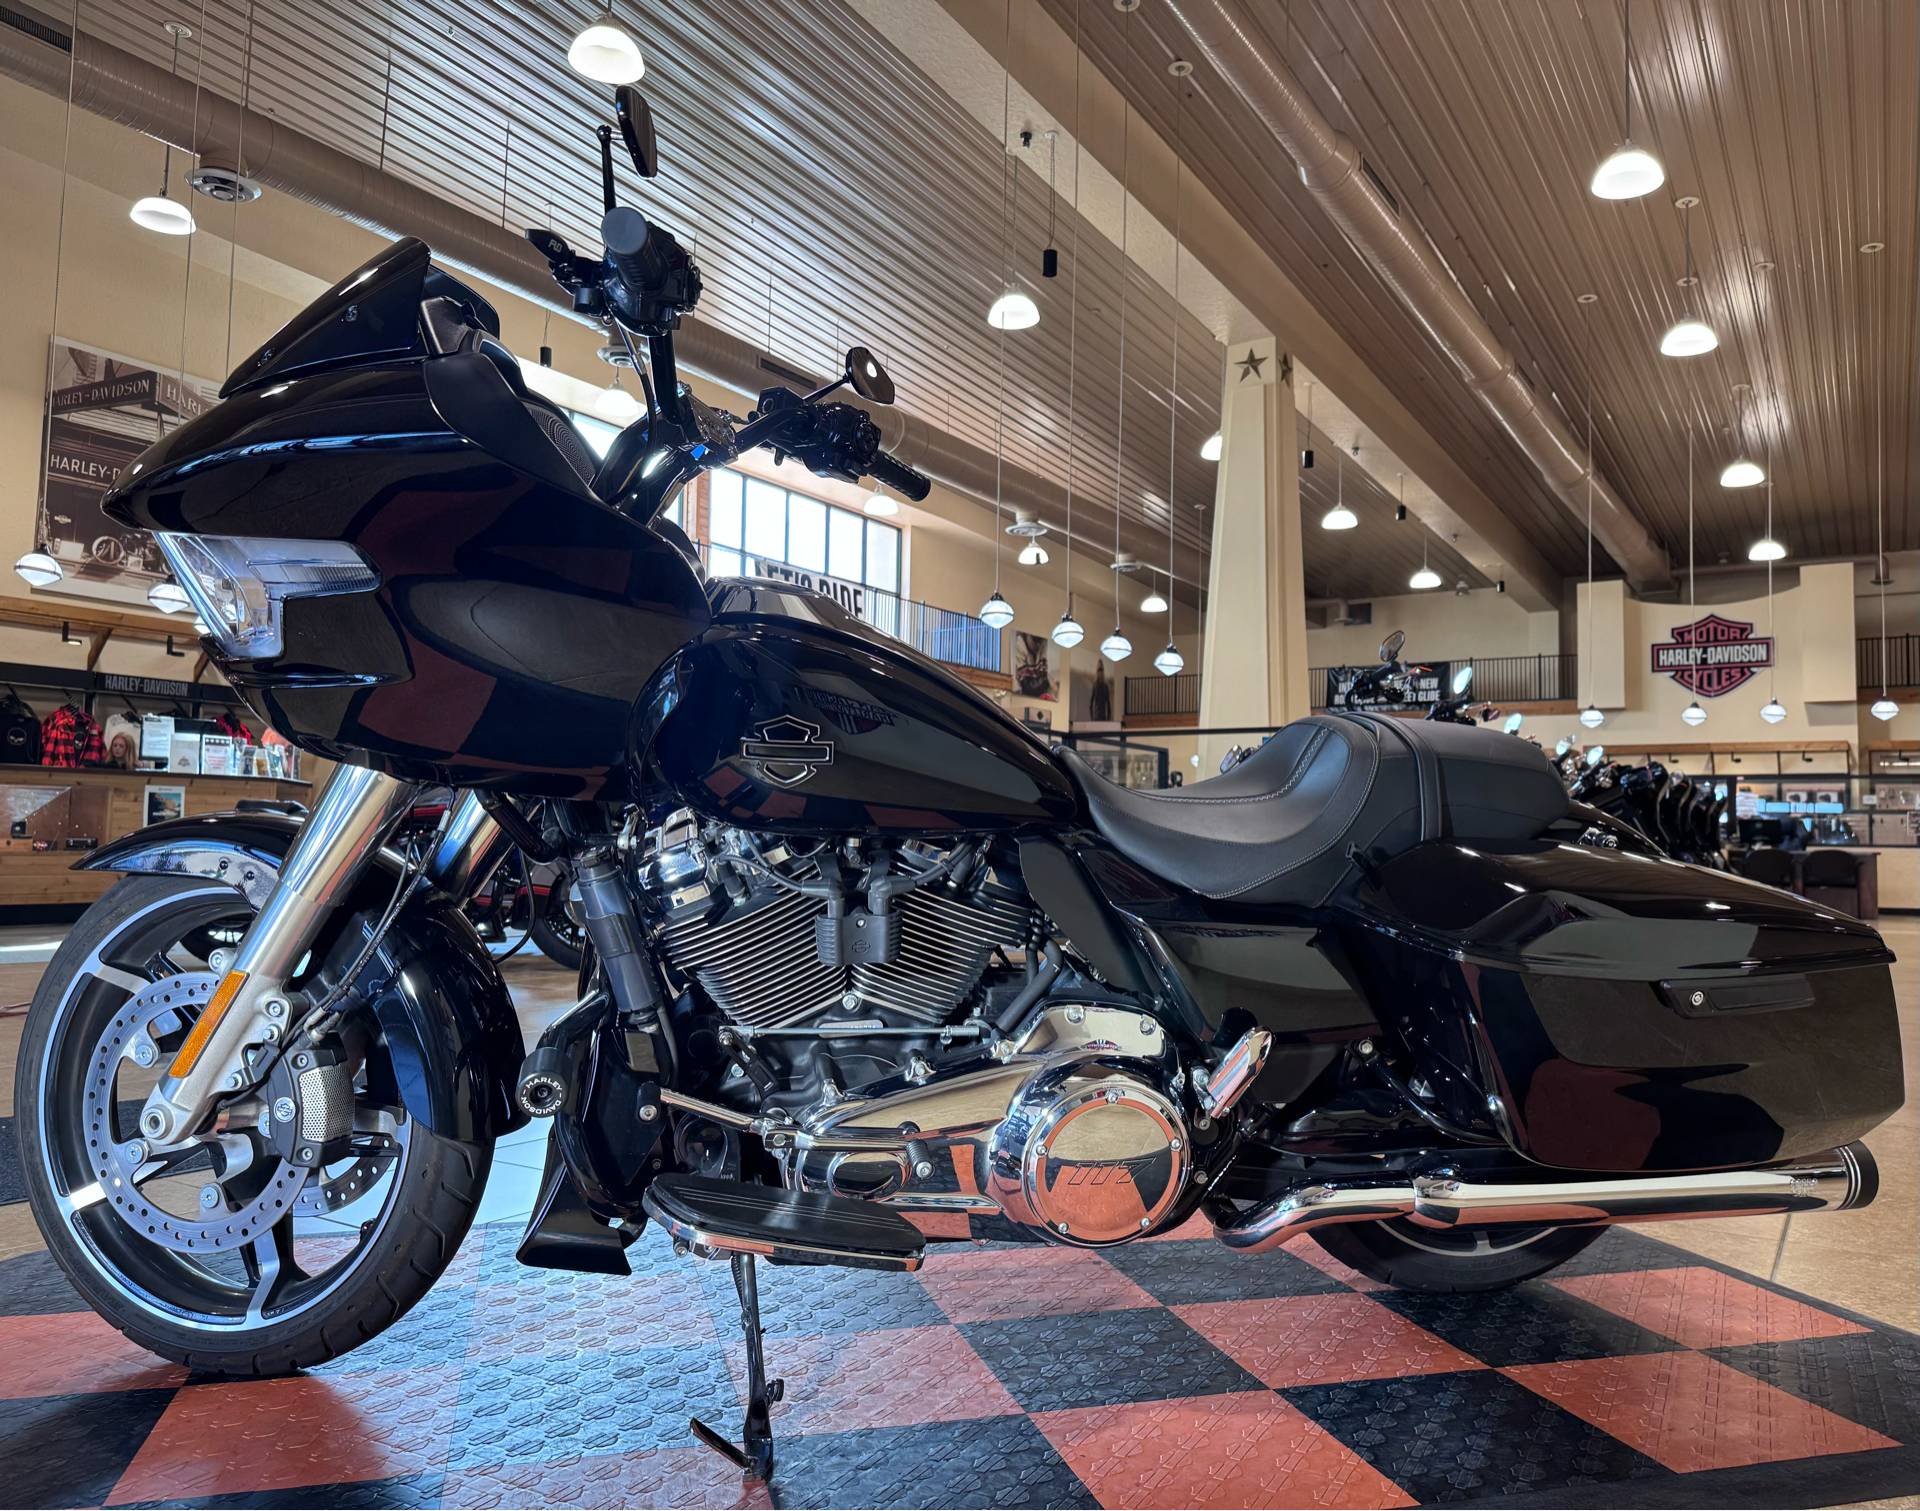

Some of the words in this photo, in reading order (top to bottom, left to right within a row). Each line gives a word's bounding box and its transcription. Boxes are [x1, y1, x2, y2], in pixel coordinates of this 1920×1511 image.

[166, 384, 208, 416] HARL
[1684, 623, 1741, 642] MOTOR
[1659, 644, 1767, 667] HARLEY-DAVIDSON
[105, 675, 188, 697] HARLEY-DAVIDSON
[1420, 677, 1439, 690] NEW
[1684, 669, 1741, 691] CYCLES
[1417, 690, 1440, 702] GLIDE
[526, 1077, 562, 1090] HARLEY
[521, 1097, 562, 1114] DAVIDSON
[1068, 1157, 1156, 1185] 117
